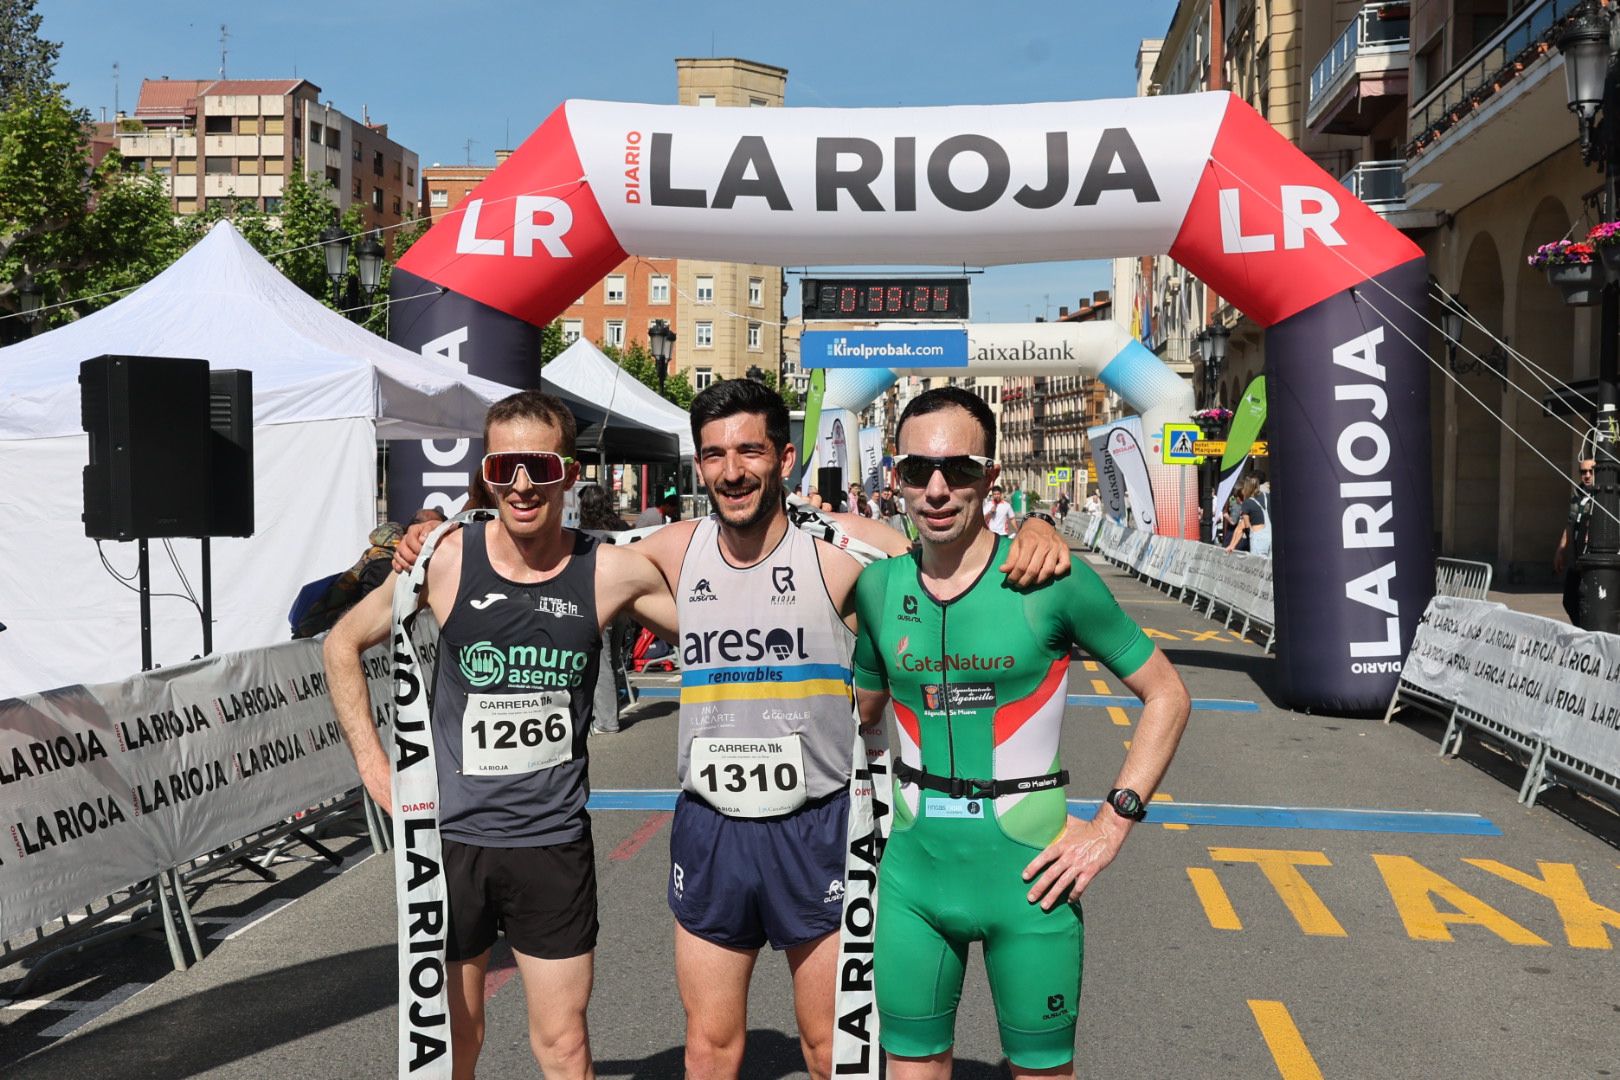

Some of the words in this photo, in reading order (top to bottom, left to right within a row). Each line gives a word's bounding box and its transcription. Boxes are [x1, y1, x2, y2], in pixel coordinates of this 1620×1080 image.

[626, 131, 641, 204] DIARIO
[650, 132, 793, 211] LA
[816, 127, 1161, 212] RIOJA
[455, 195, 573, 258] LR
[1218, 185, 1348, 254] LR
[832, 341, 944, 359] Kirolprobak.com
[1332, 325, 1395, 549] RIOJA
[1346, 560, 1402, 658] LA
[508, 668, 583, 687] asensio
[509, 645, 588, 671] muro
[709, 666, 783, 684] renovables
[902, 653, 1015, 672] CataNatura
[152, 703, 210, 745] RIOJA
[480, 700, 539, 710] CARRERA
[29, 730, 108, 775] RIOJA
[471, 713, 567, 750] 1266
[709, 744, 767, 753] CARRERA
[168, 759, 228, 803] RIOJA
[700, 762, 798, 793] 1310
[54, 794, 126, 843] RIOJA
[402, 801, 435, 812] DIARIO
[404, 818, 441, 892] LA
[841, 830, 878, 992] RIOJA
[408, 900, 447, 1072] RIOJA
[835, 1001, 872, 1075] LA
